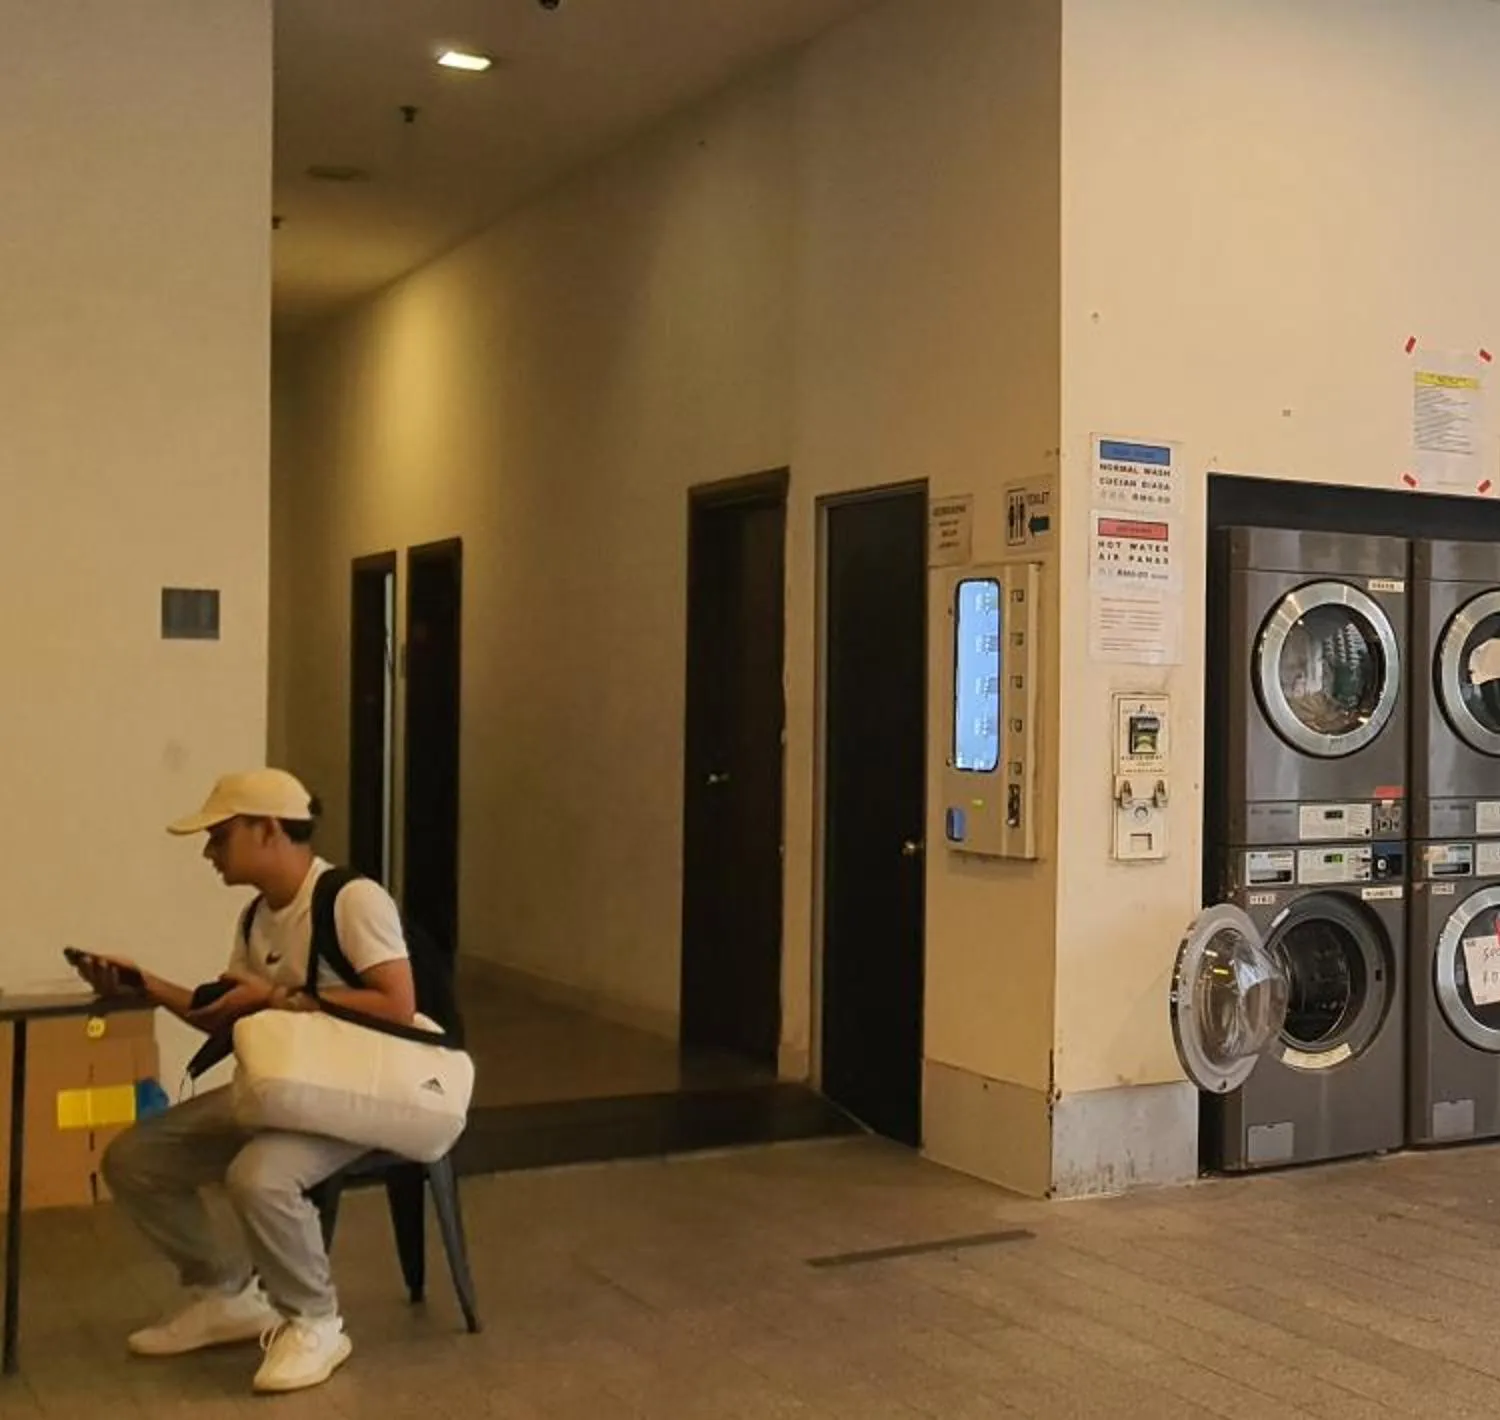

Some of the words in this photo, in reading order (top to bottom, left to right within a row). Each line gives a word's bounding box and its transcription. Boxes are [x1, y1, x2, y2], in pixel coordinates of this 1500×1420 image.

[1099, 463, 1139, 474] NORMAL
[1143, 468, 1171, 477] WASH
[1099, 477, 1137, 488] CUCIAN
[1098, 541, 1121, 549] HOT
[1129, 543, 1169, 552] WATER
[1098, 552, 1120, 561] AIR
[1129, 555, 1169, 565] PANAS
